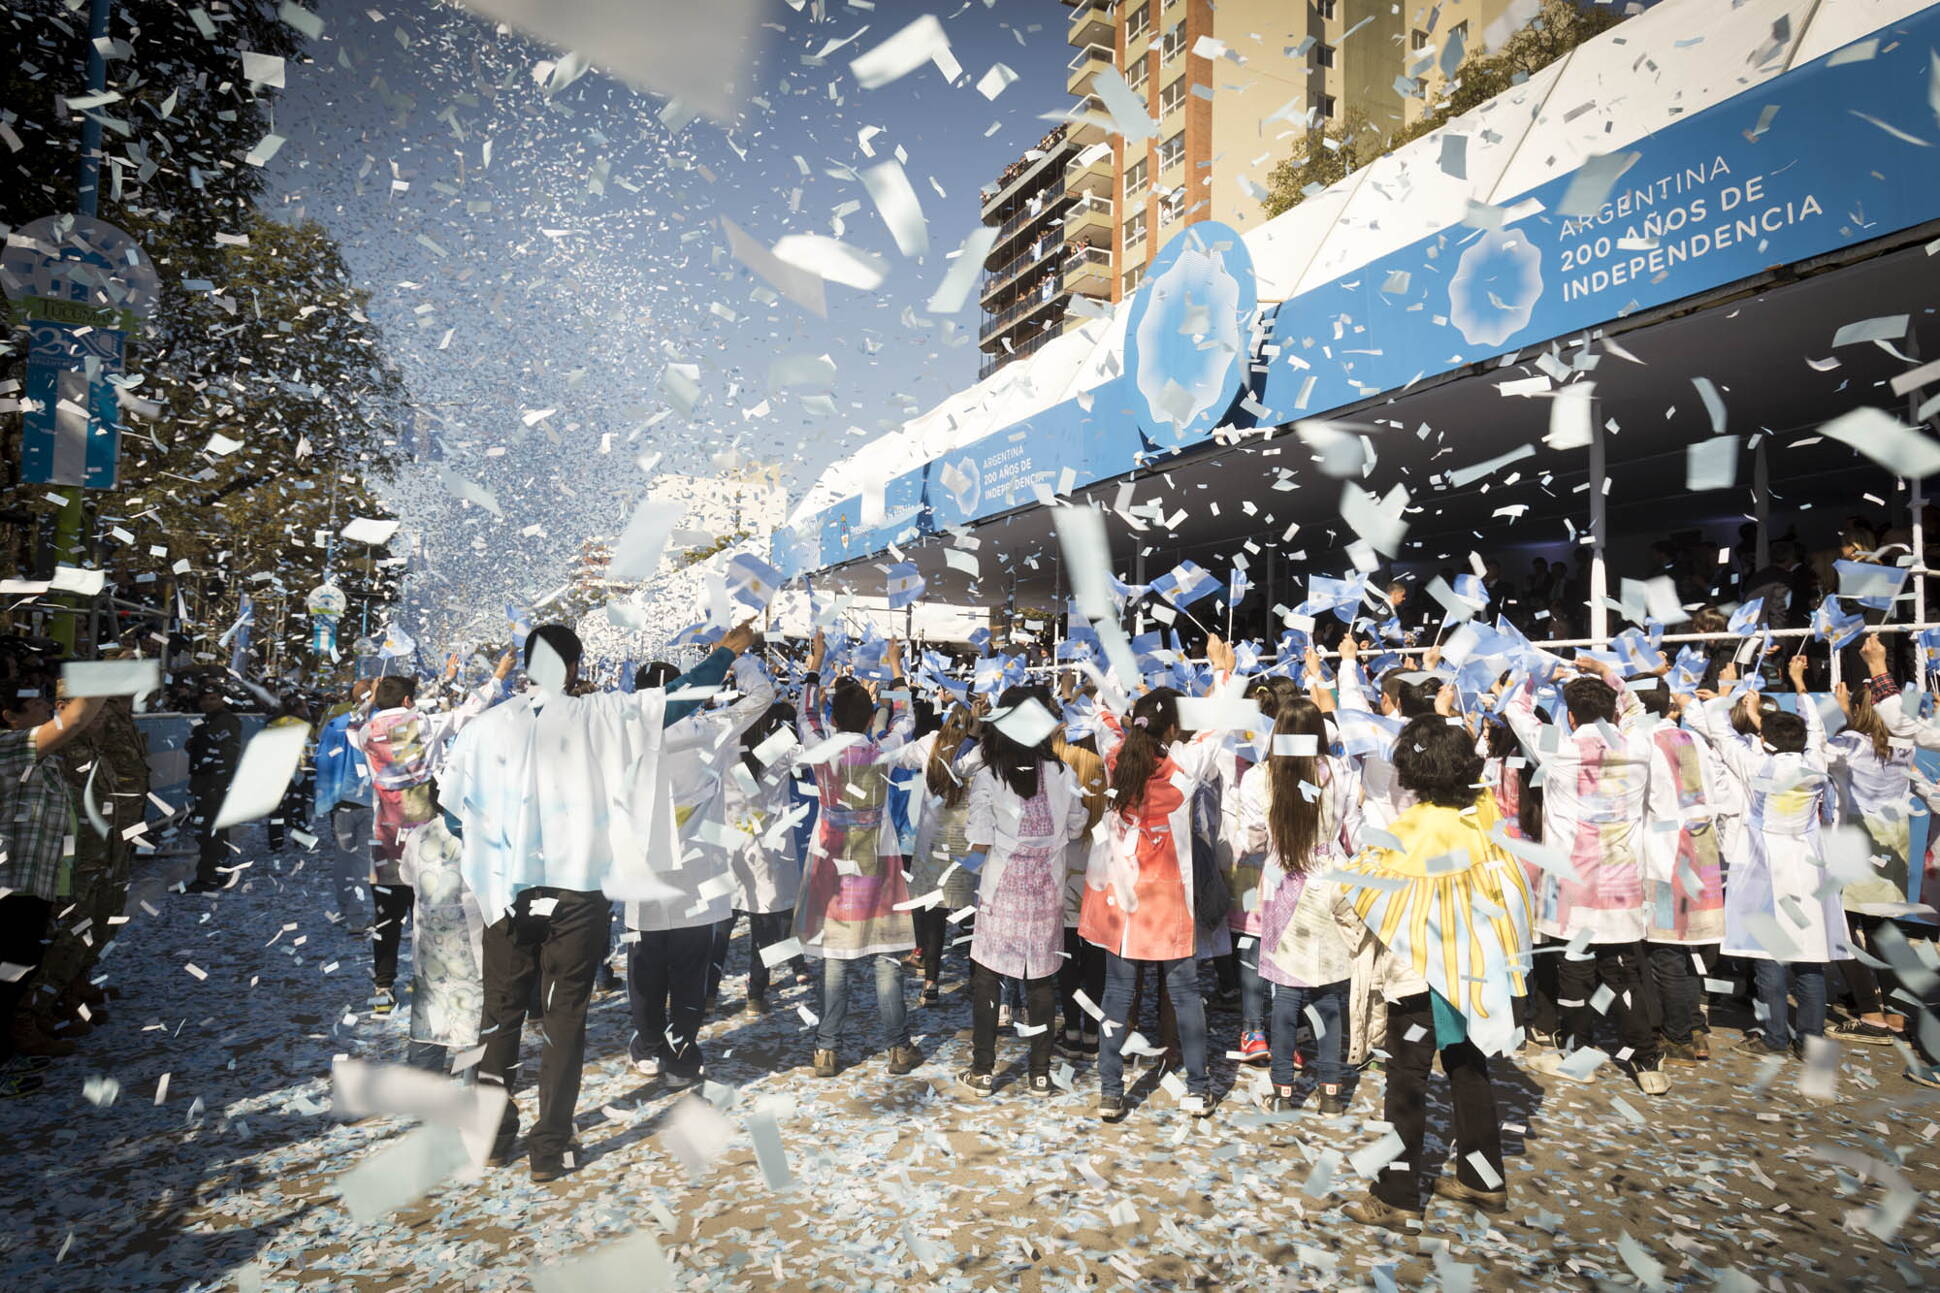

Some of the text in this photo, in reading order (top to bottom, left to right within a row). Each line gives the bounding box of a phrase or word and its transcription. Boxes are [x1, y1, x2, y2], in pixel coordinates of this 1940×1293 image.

[1559, 155, 1731, 242] ARGENTINA
[1560, 175, 1765, 272] 200 AÑOS DE
[1563, 194, 1823, 303] INDEPENDENCIA
[983, 444, 1024, 468] ARGENTINA
[1020, 455, 1033, 472] DE
